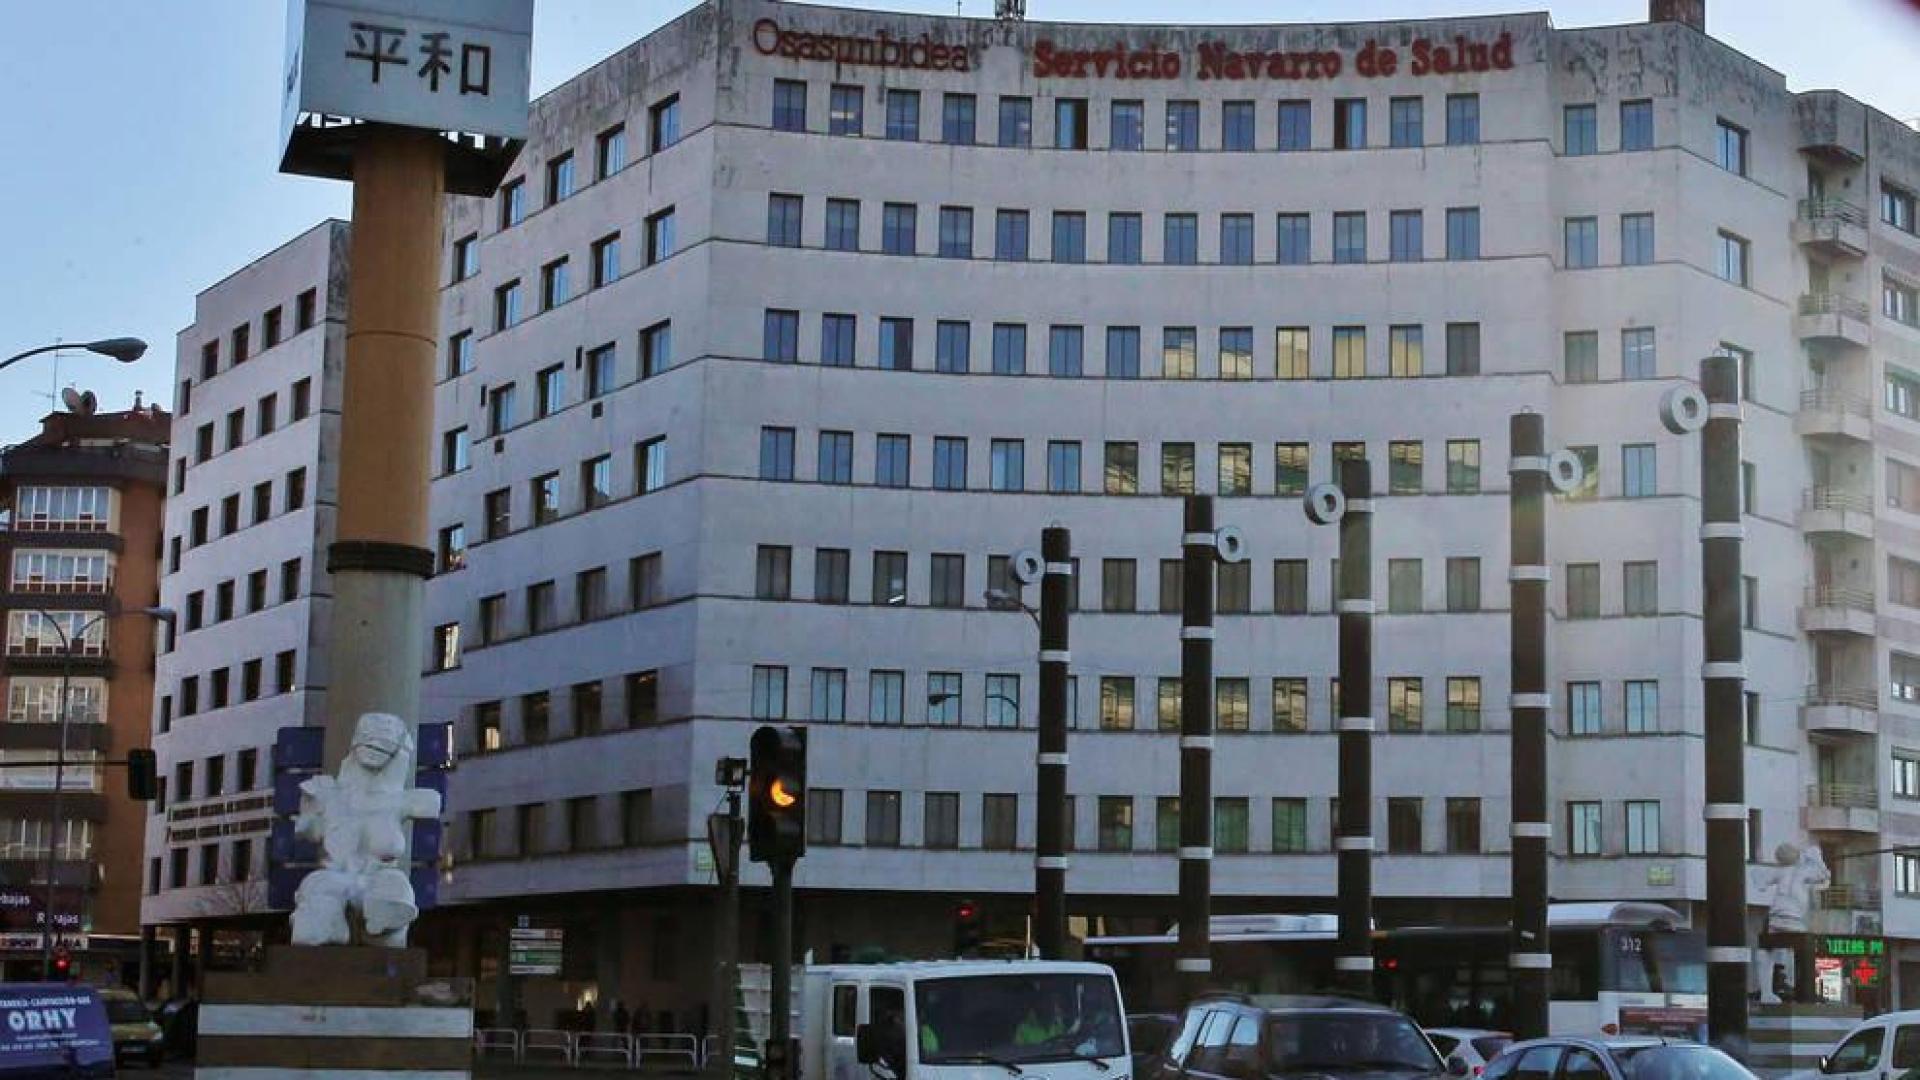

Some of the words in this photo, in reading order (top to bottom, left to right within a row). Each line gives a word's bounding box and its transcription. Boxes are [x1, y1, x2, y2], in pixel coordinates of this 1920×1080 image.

[345, 21, 491, 96] 平和
[753, 18, 969, 73] Osasunbidea
[1034, 40, 1180, 80] Servicio
[1197, 41, 1342, 80] Navarro
[1356, 39, 1397, 78] de
[1410, 32, 1514, 77] Salud
[8, 1007, 77, 1032] ORHY
